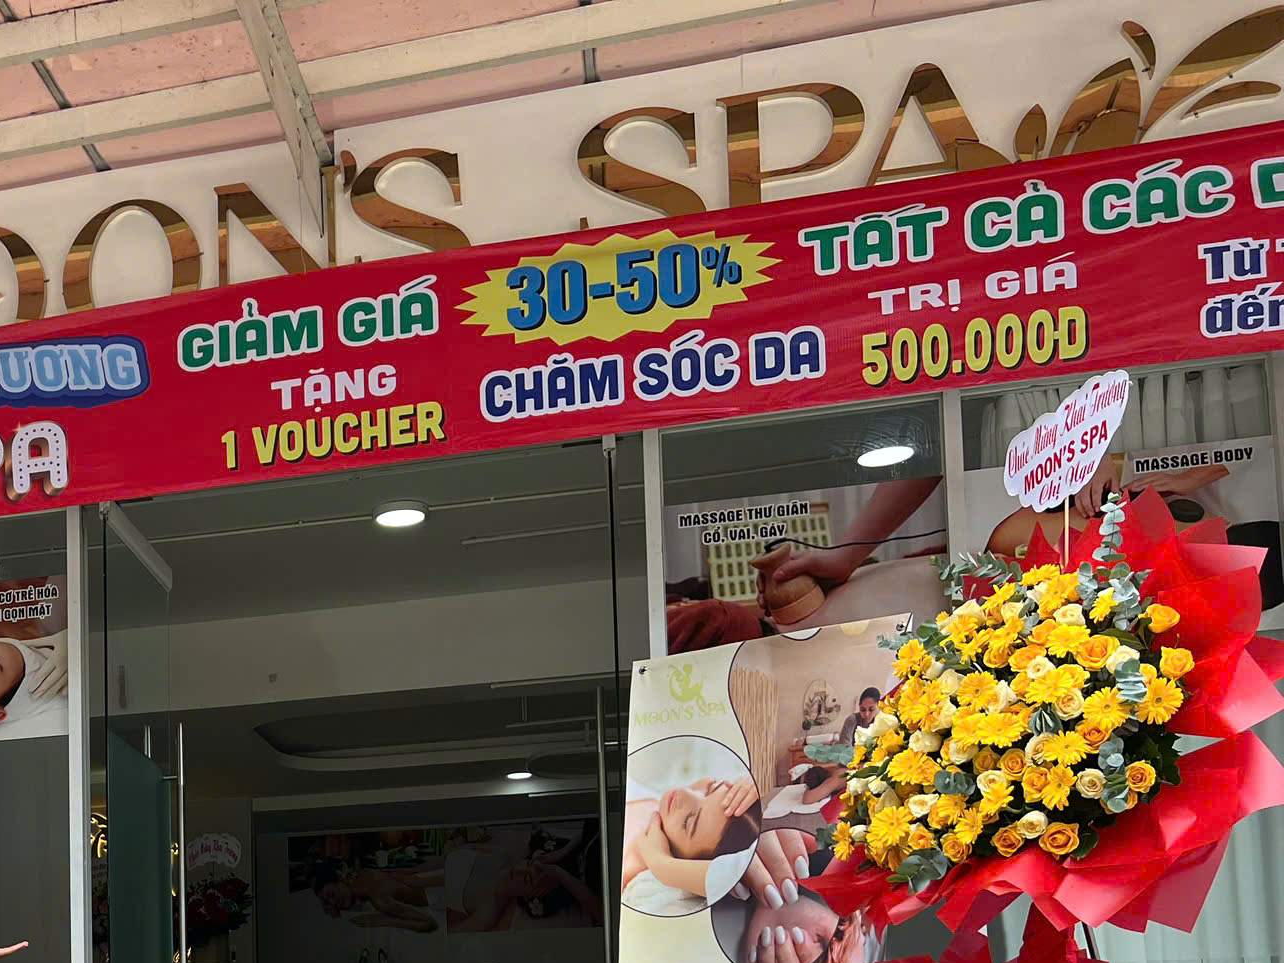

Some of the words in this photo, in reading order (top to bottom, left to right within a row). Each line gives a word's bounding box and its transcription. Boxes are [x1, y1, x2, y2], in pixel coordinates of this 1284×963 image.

[800, 204, 947, 274] TẤT
[967, 180, 1063, 250] CẢ
[1085, 159, 1233, 233] CÁC
[505, 242, 742, 331] 30-50%
[866, 279, 962, 316] TRỊ
[984, 251, 1078, 300] GIÁ
[179, 299, 322, 370] GIẢM
[340, 275, 437, 345] GIÁ
[270, 364, 397, 413] TẶNG
[482, 356, 623, 420] CHĂM
[636, 331, 738, 398] SÓC
[751, 328, 825, 384] DA
[221, 430, 239, 470] 1
[252, 401, 448, 466] VOUCHER
[1024, 439, 1075, 496] MOON'S
[1079, 420, 1108, 454] SPA
[1135, 451, 1210, 473] MASSAGE
[1213, 447, 1254, 463] BODY
[679, 509, 743, 527] MASSAGE
[746, 505, 773, 520] THƯ
[776, 501, 809, 517] GIÃN
[759, 523, 785, 538] GÁY
[4, 607, 25, 622] GỌN
[28, 603, 52, 619] MẶT
[36, 584, 58, 599] HÓA
